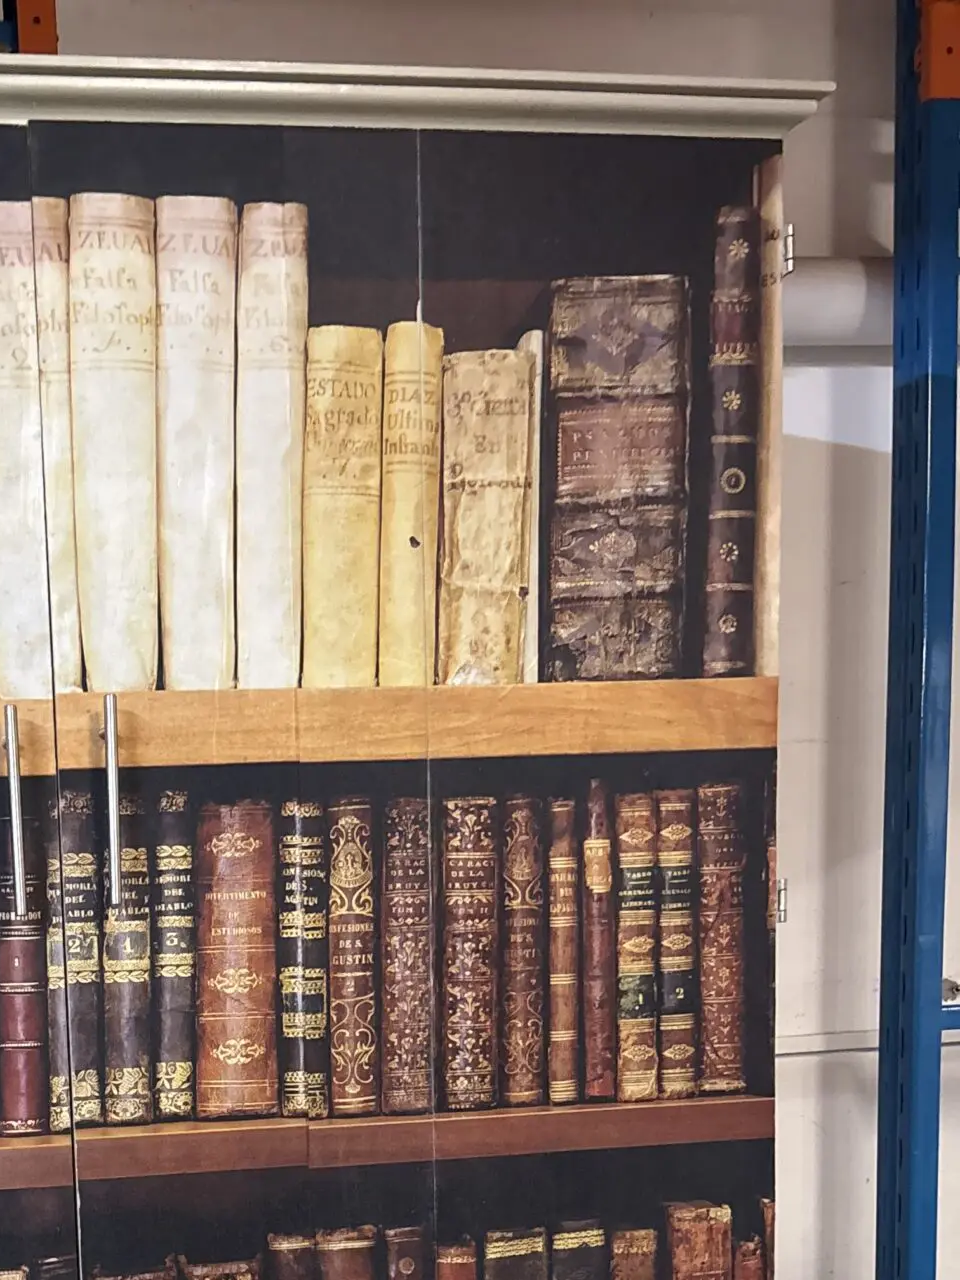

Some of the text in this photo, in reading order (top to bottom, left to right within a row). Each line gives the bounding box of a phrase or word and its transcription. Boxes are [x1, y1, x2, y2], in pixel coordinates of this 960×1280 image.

[68, 937, 81, 953] 2
[122, 936, 134, 953] 1
[675, 987, 685, 999] 2
